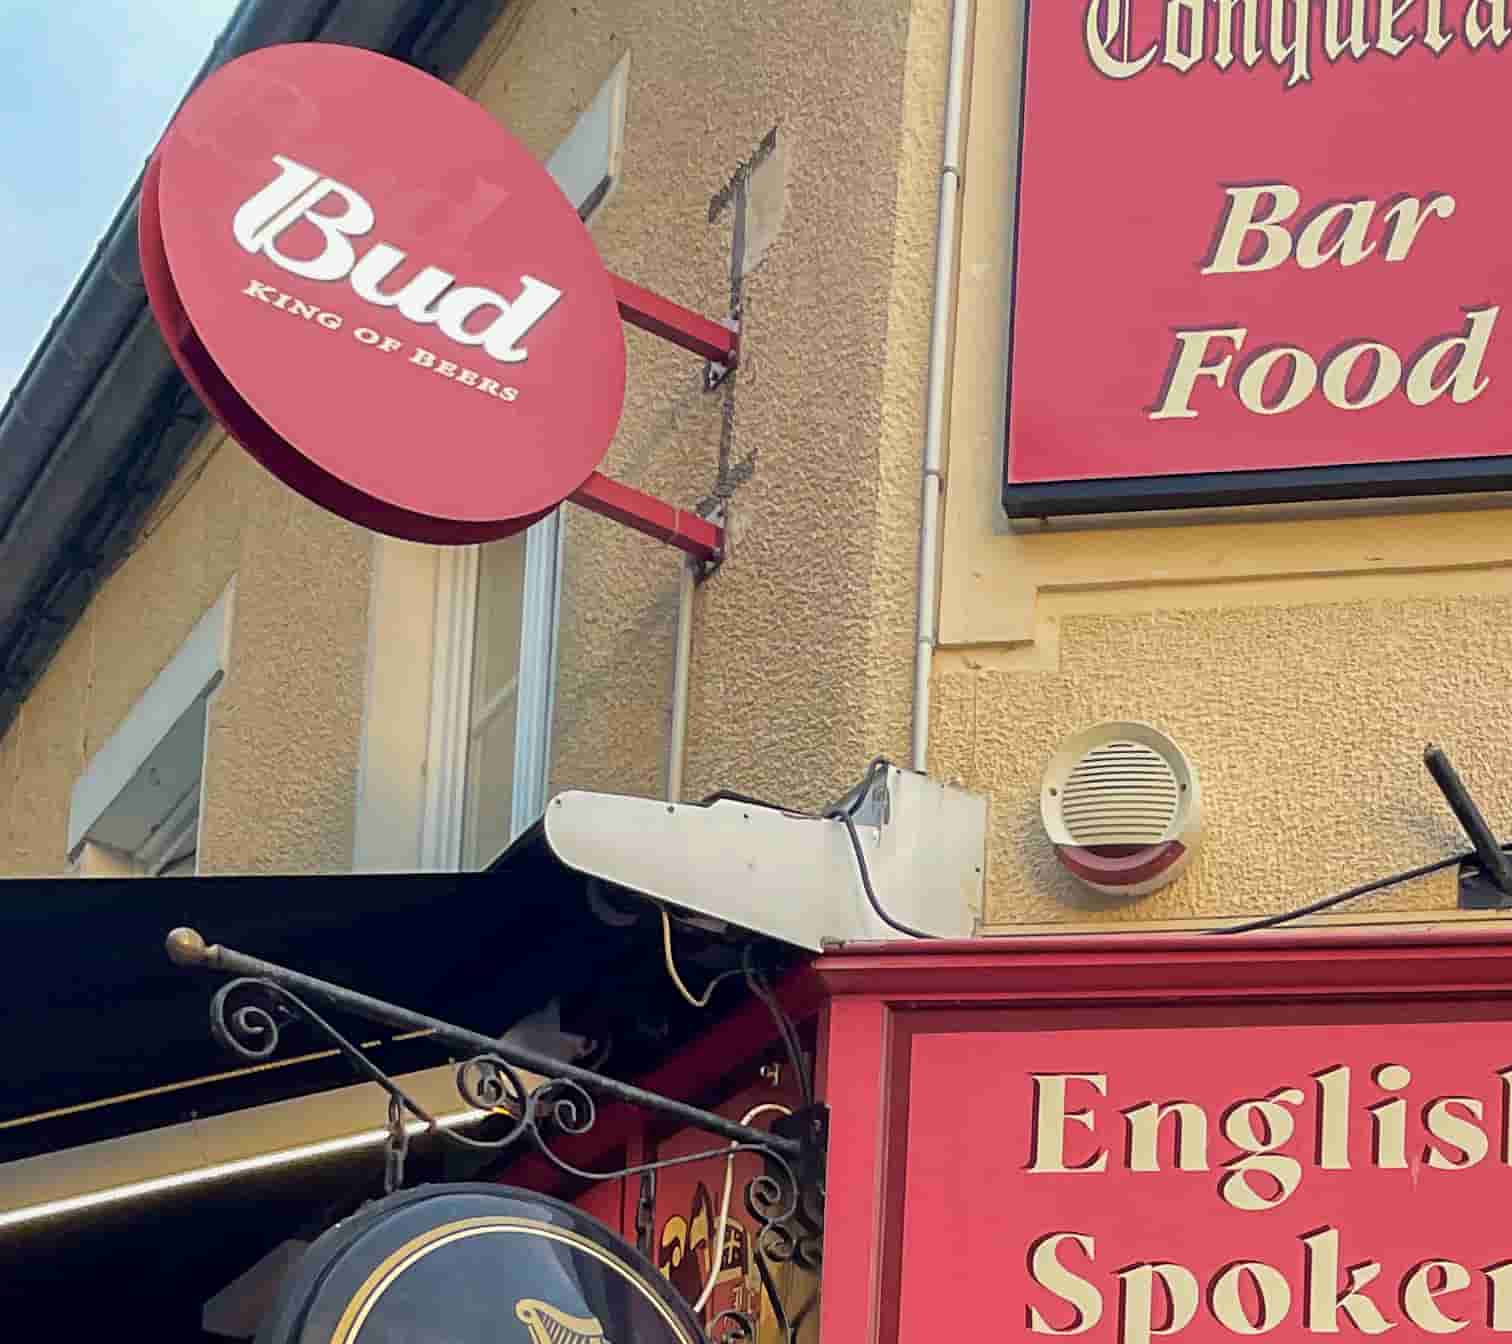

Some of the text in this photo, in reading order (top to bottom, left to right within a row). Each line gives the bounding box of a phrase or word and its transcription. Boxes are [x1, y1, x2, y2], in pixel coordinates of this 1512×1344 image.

[232, 153, 563, 363] Bud
[1197, 178, 1456, 276] Bar
[242, 279, 520, 403] KING OF BEERS
[1143, 302, 1500, 420] Food
